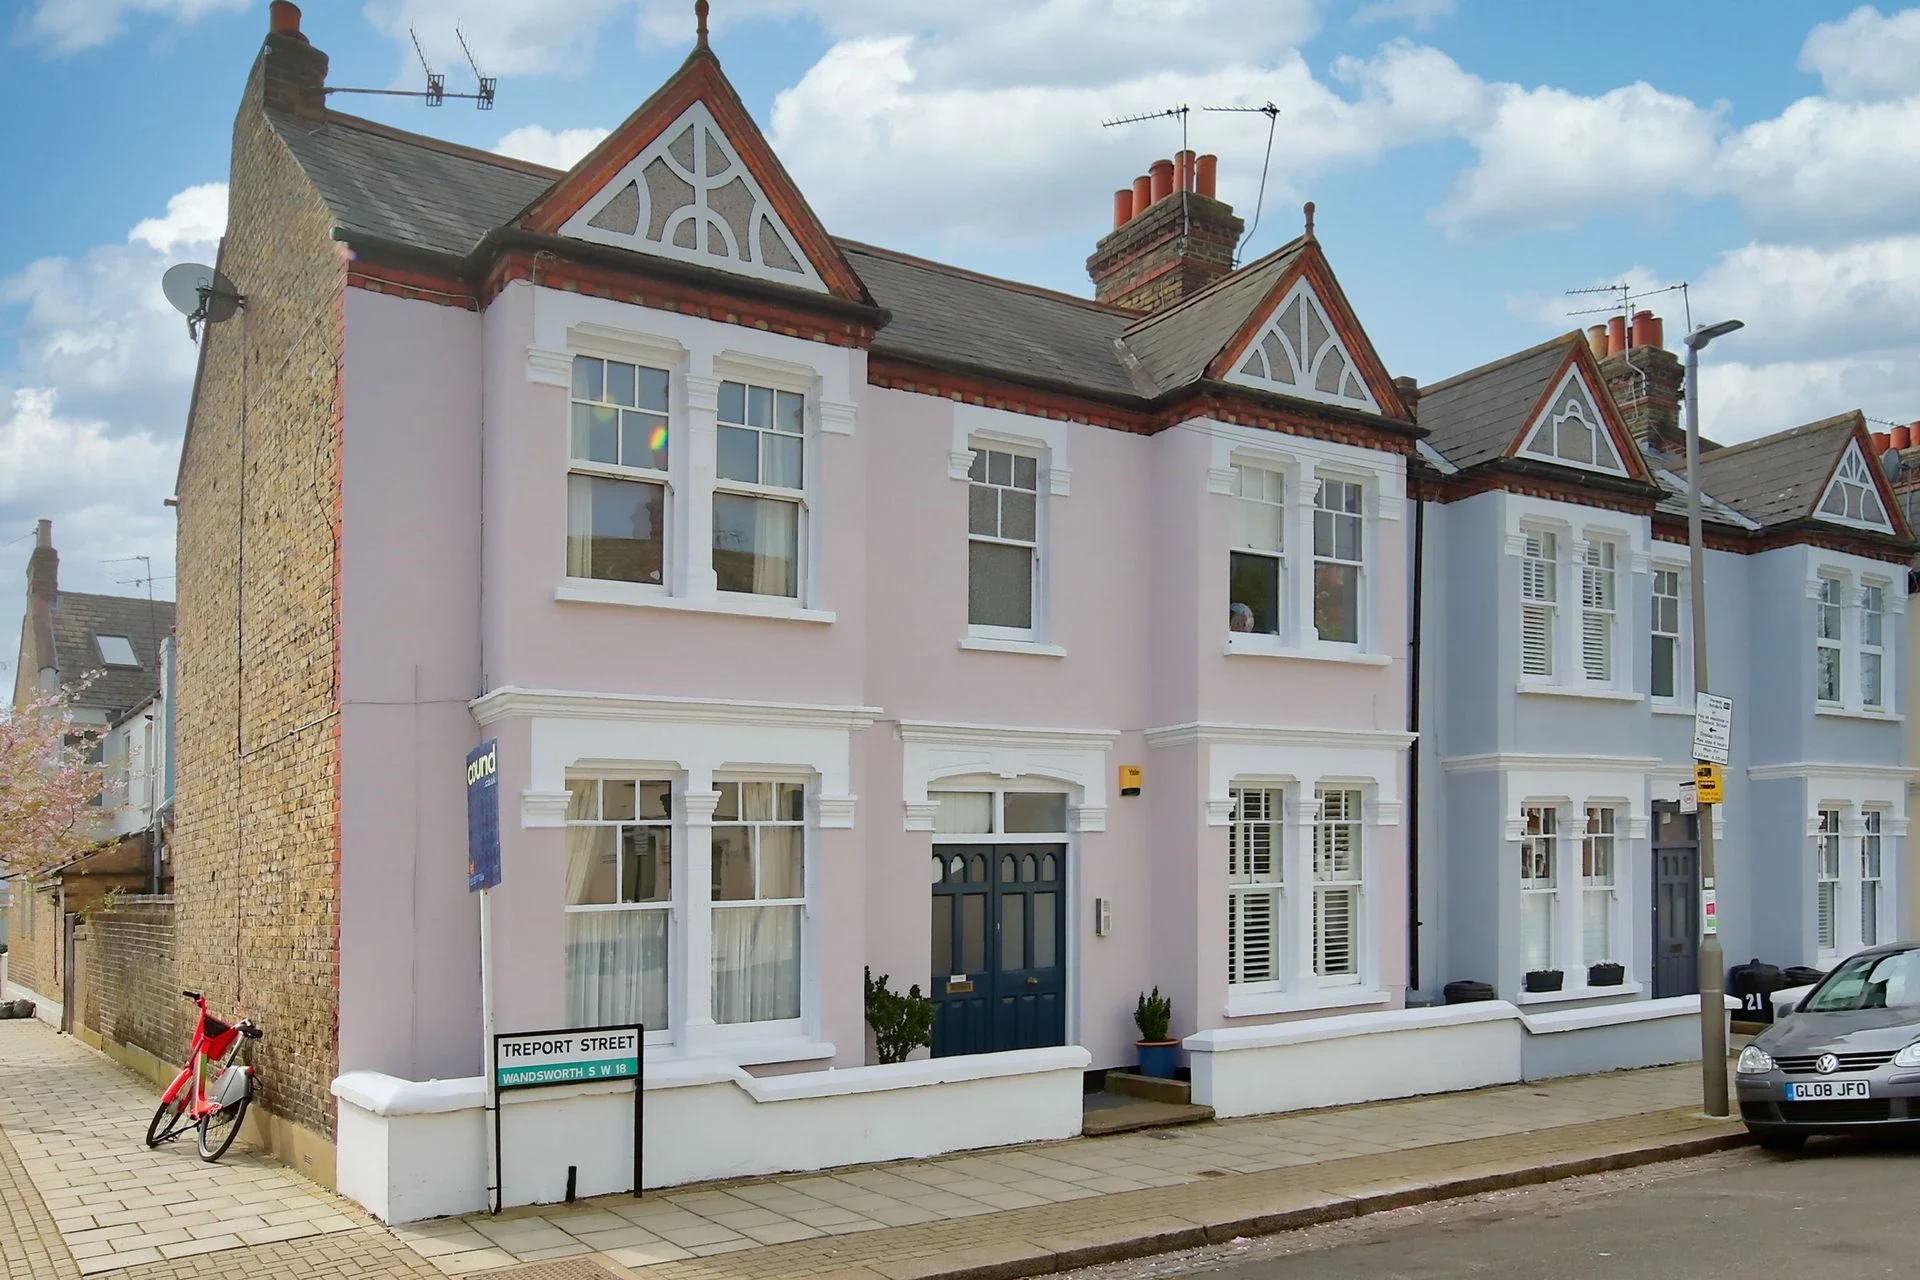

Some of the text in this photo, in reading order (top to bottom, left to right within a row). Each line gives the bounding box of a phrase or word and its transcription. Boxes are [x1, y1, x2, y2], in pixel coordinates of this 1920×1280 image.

[1745, 992, 1763, 1011] 21
[502, 1035, 635, 1058] TREPORT STREET
[502, 1063, 627, 1085] WANDSWORTH S W 18
[1795, 1081, 1867, 1098] GL08 JFO
